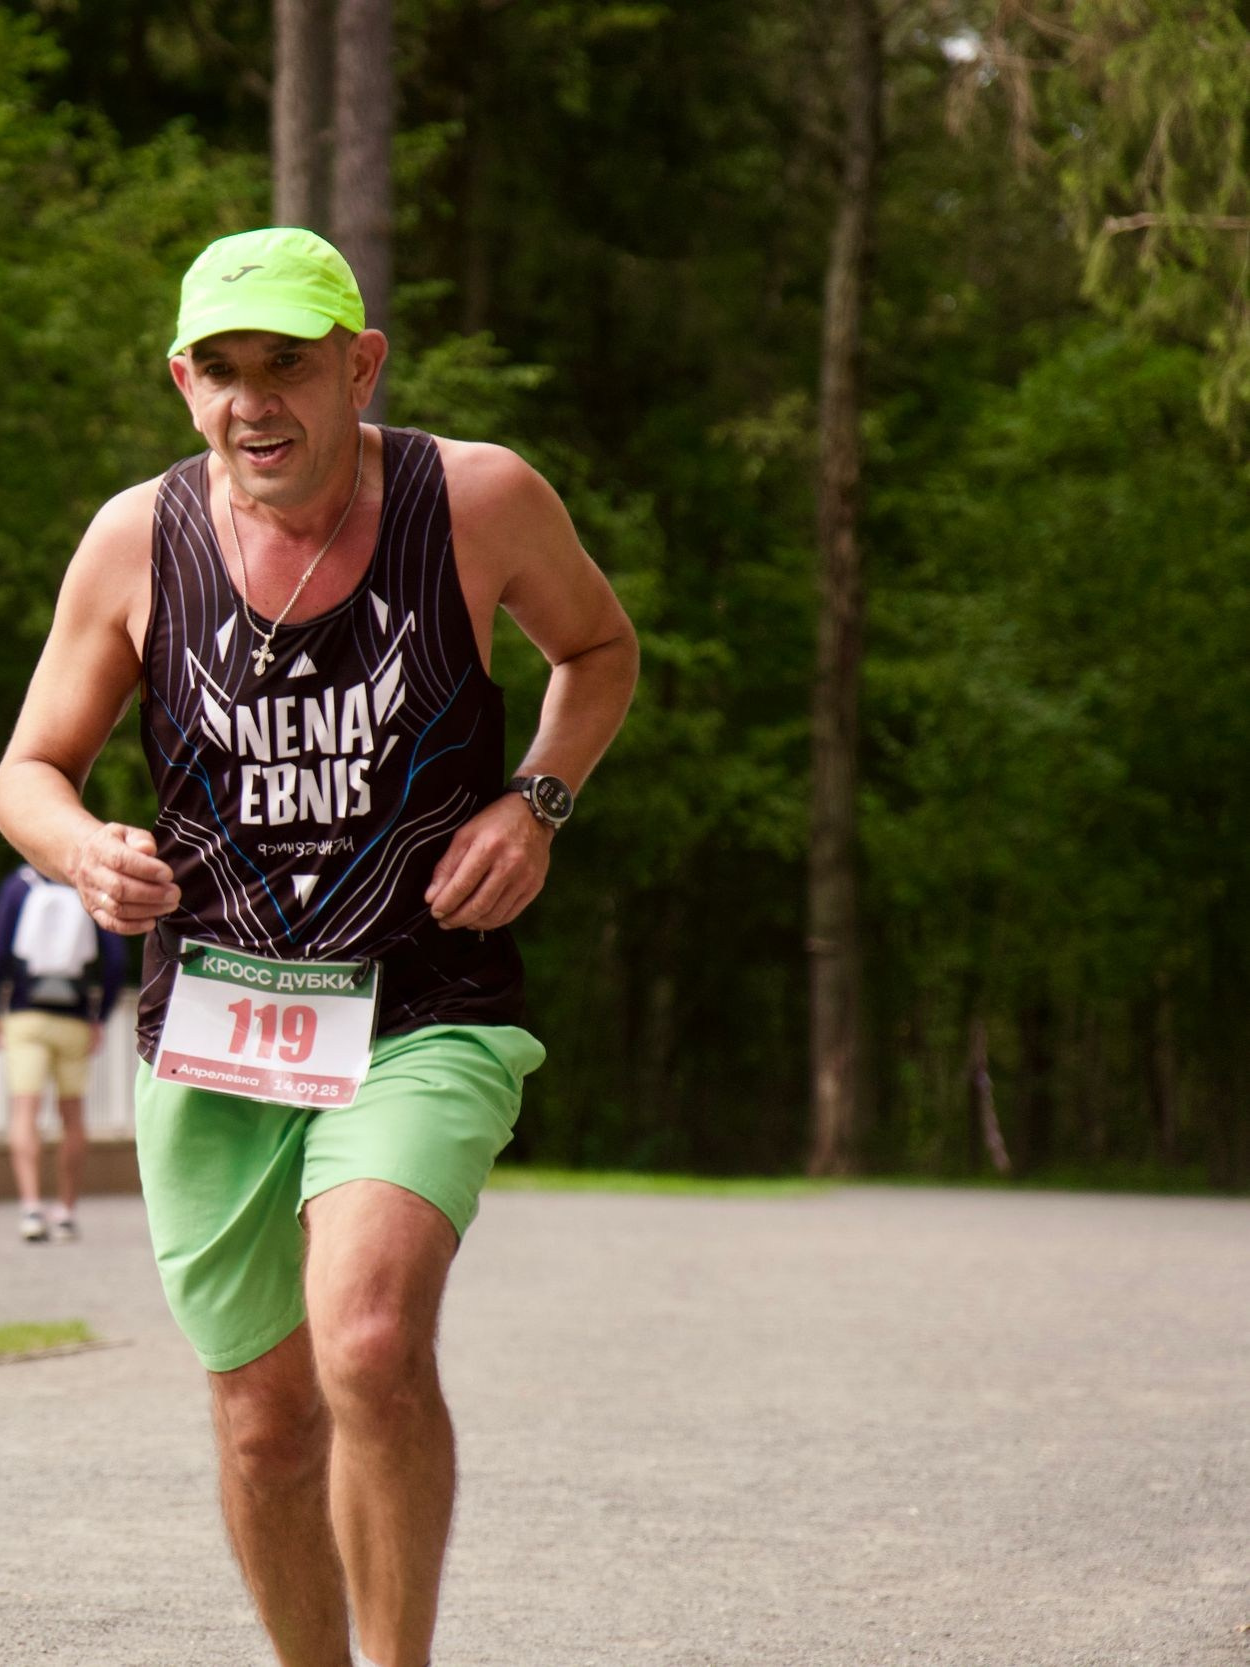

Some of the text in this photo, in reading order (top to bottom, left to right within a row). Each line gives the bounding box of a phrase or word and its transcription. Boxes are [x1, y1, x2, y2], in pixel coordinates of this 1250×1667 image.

[235, 682, 374, 763] NENA
[240, 758, 372, 826] EBNIS
[202, 955, 355, 991] КРОСС ДУБКИ
[228, 998, 318, 1064] 119
[178, 1063, 340, 1098] Апрелевка 14.09.25
